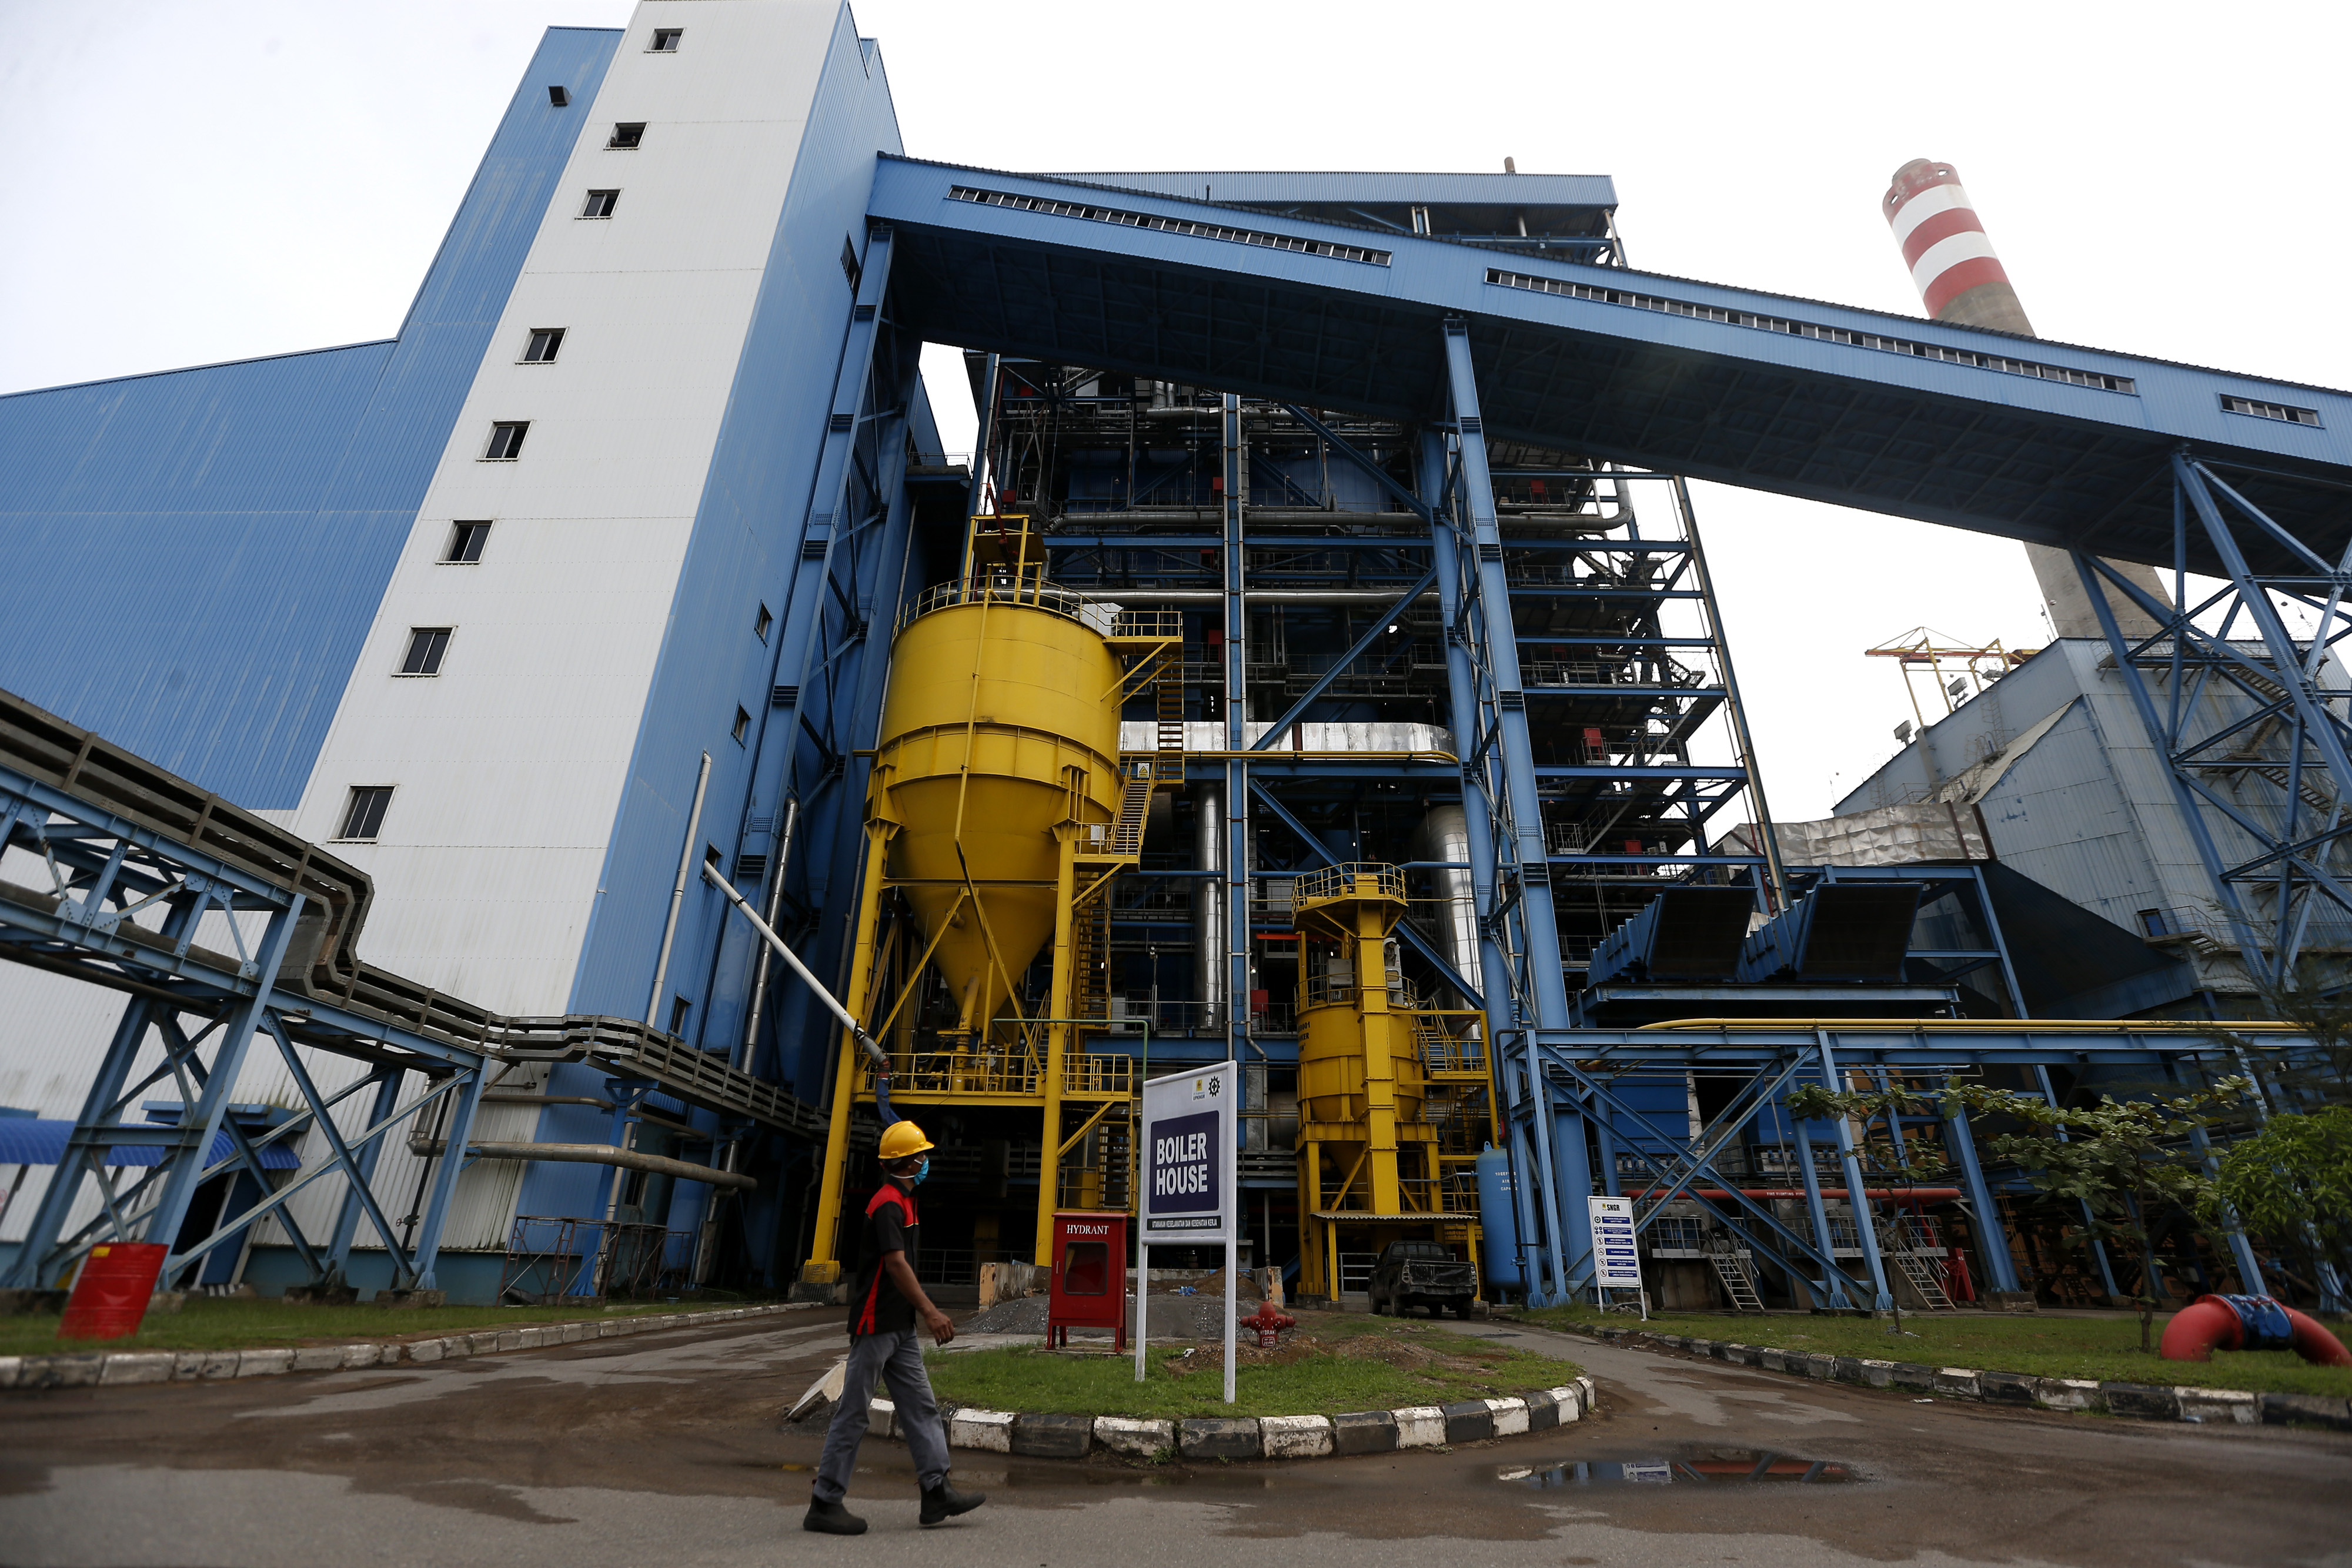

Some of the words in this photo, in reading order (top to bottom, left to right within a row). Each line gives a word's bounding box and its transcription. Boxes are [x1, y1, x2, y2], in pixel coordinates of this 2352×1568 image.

[1156, 1132, 1207, 1165] BOILER
[1156, 1164, 1208, 1196] HOUSE
[1067, 1224, 1109, 1235] HYDRANT
